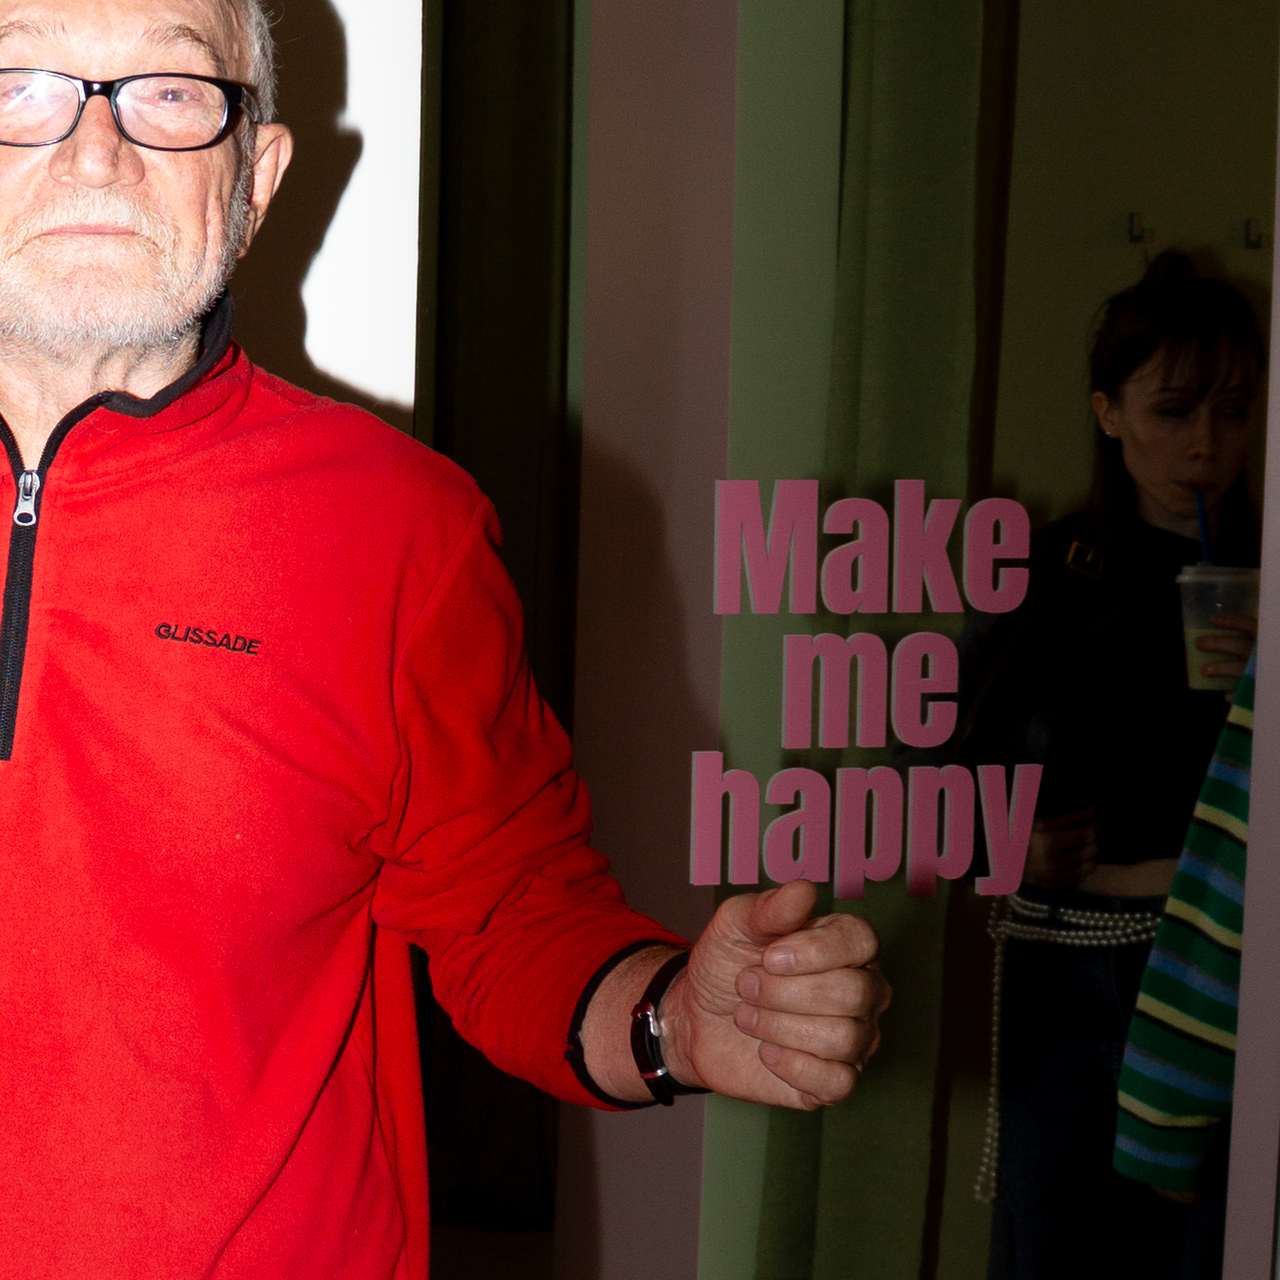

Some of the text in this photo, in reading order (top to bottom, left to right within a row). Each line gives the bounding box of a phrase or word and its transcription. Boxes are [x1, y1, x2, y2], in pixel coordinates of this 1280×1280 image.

[713, 479, 1031, 614] Make
[155, 622, 262, 656] GLISSADE
[781, 632, 959, 749] me
[690, 751, 1044, 899] happy
